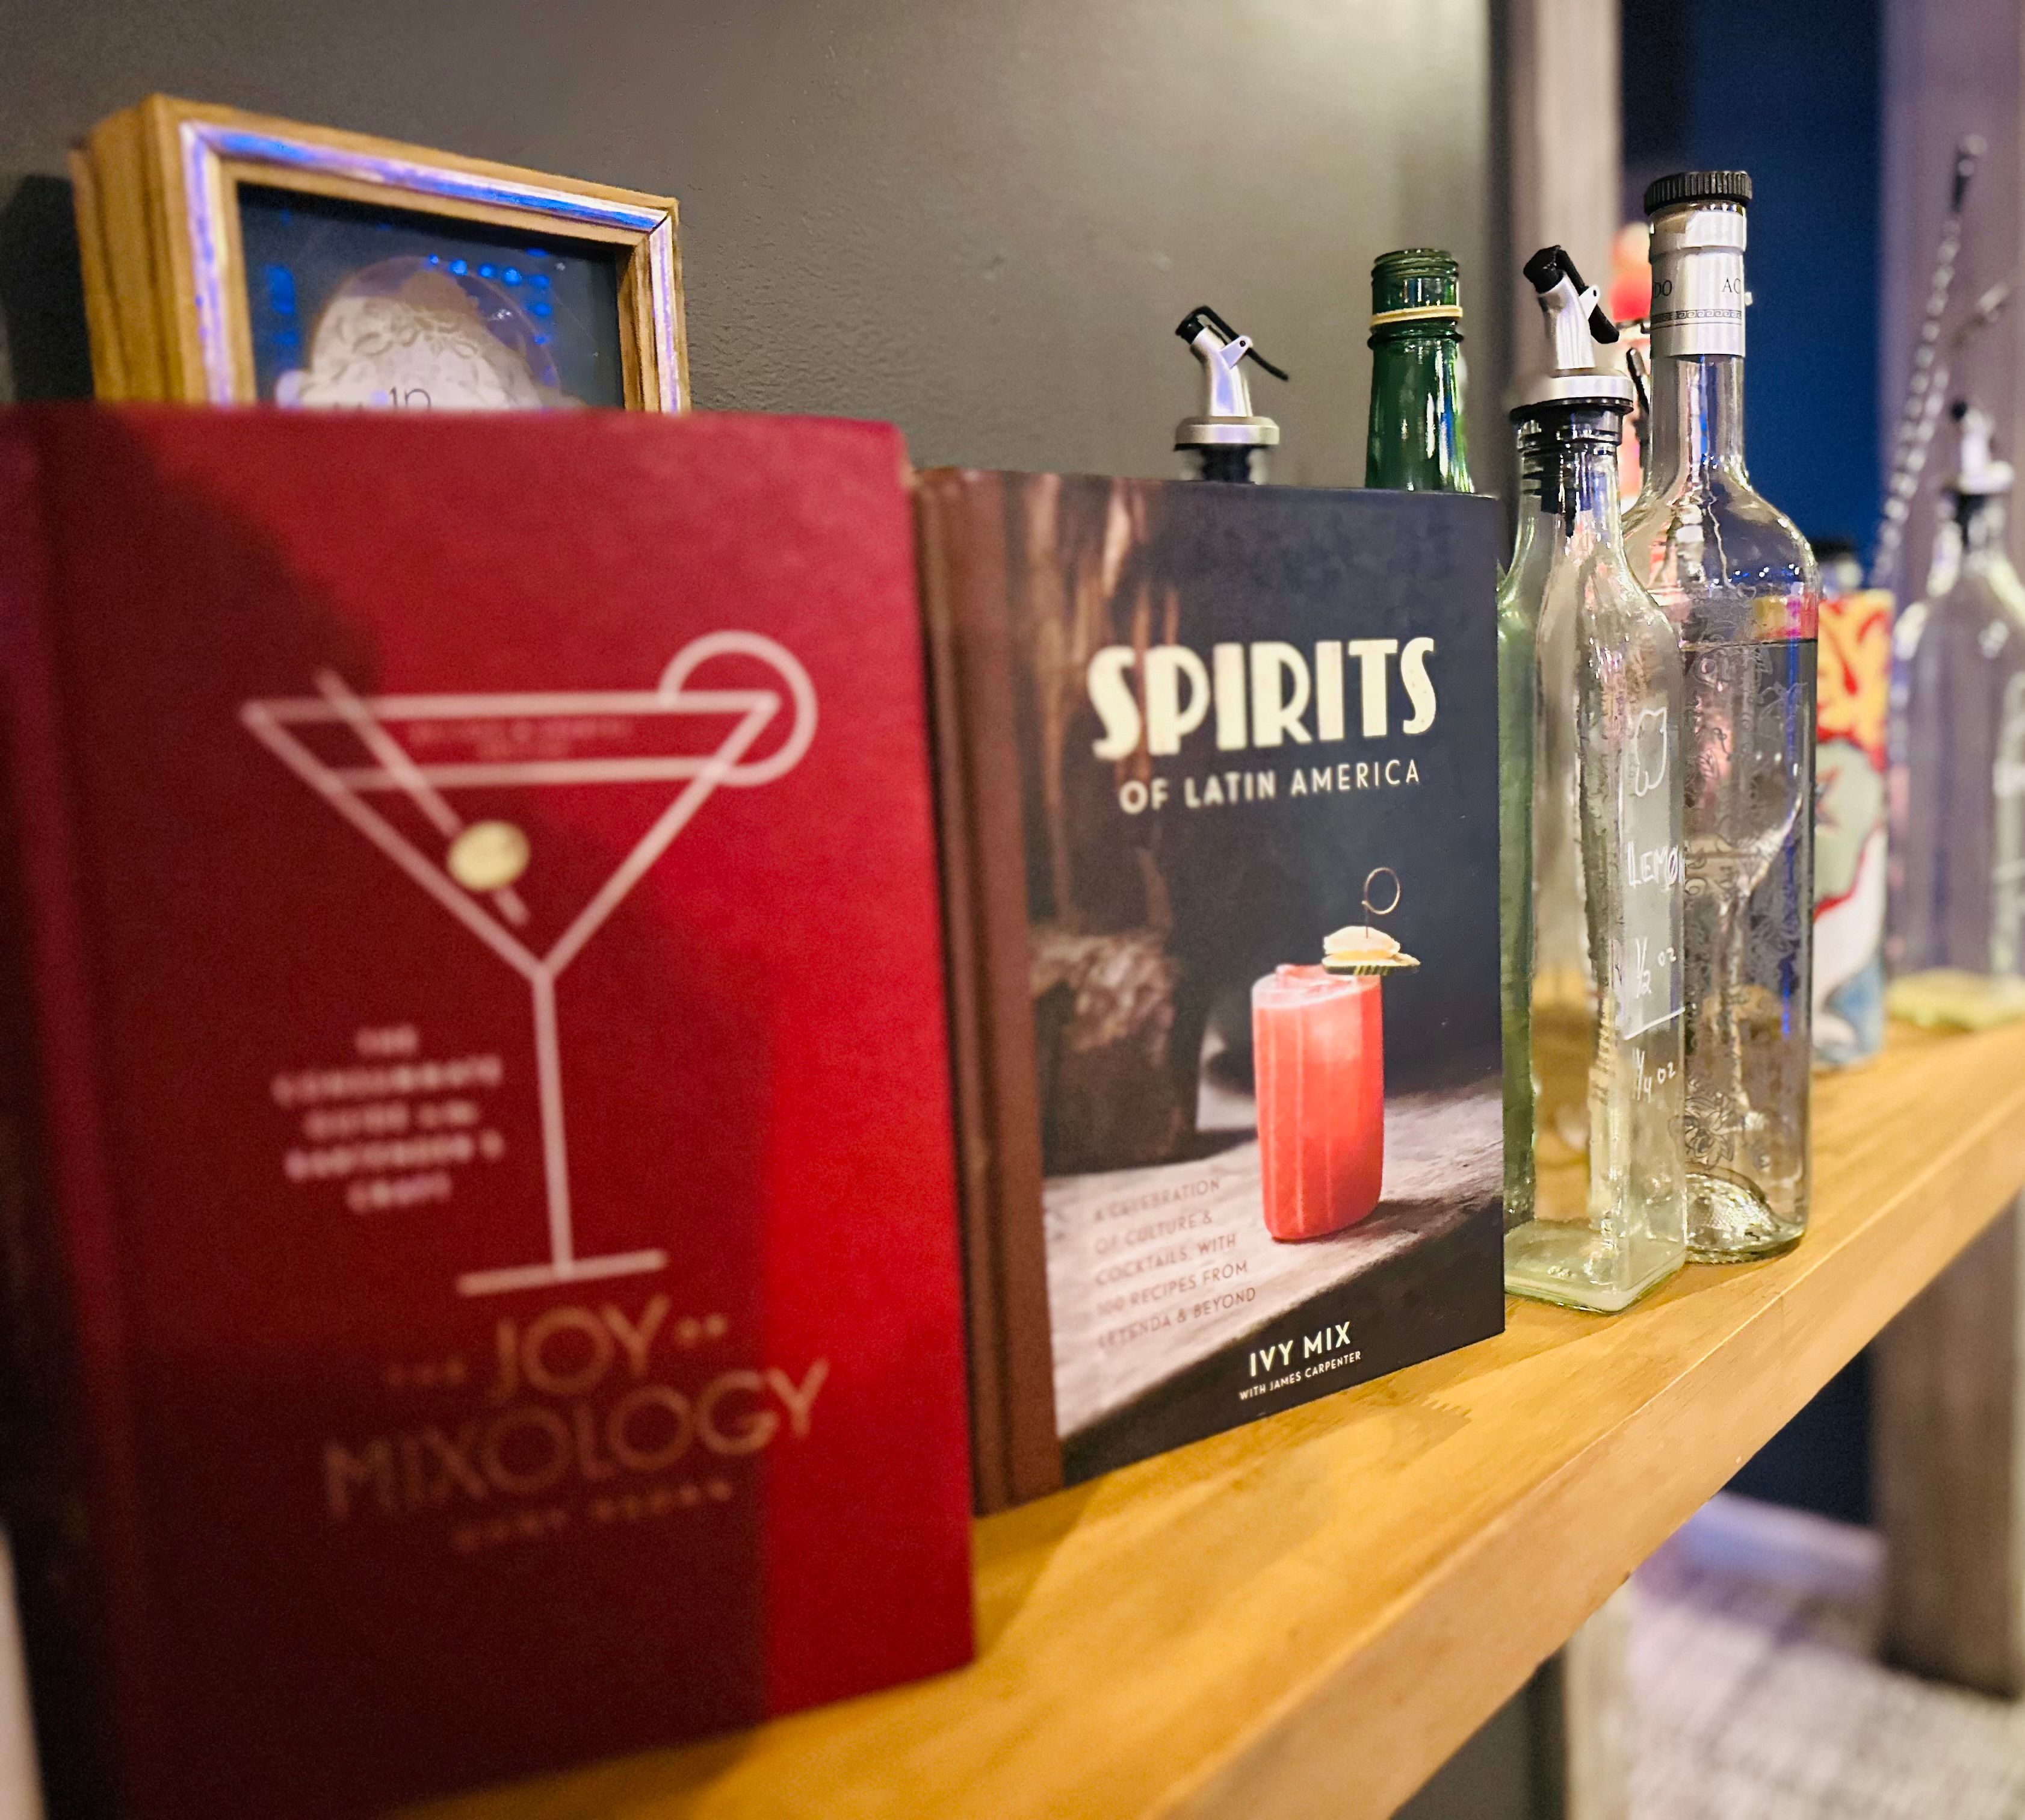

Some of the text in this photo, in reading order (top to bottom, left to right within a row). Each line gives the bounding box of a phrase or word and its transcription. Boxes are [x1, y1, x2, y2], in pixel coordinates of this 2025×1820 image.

[1087, 637, 1437, 761] SPIRITS
[1118, 759, 1420, 814] OF LATIN AMERICA
[1108, 1178, 1220, 1218] CELEBRATION
[1124, 1212, 1197, 1246] CULTURE
[1203, 1209, 1213, 1224] &
[1196, 1233, 1237, 1255] WITH
[1130, 1274, 1196, 1306] RECIPES
[1203, 1260, 1248, 1286] FROM
[1176, 1307, 1187, 1323] &
[1193, 1287, 1256, 1319] BEYOND
[486, 1293, 673, 1404] JOY
[1249, 1321, 1351, 1377] IVY MIX
[1238, 1351, 1362, 1401] WITH JAMES CARPENTER
[323, 1358, 832, 1521] MIXOLOGY
